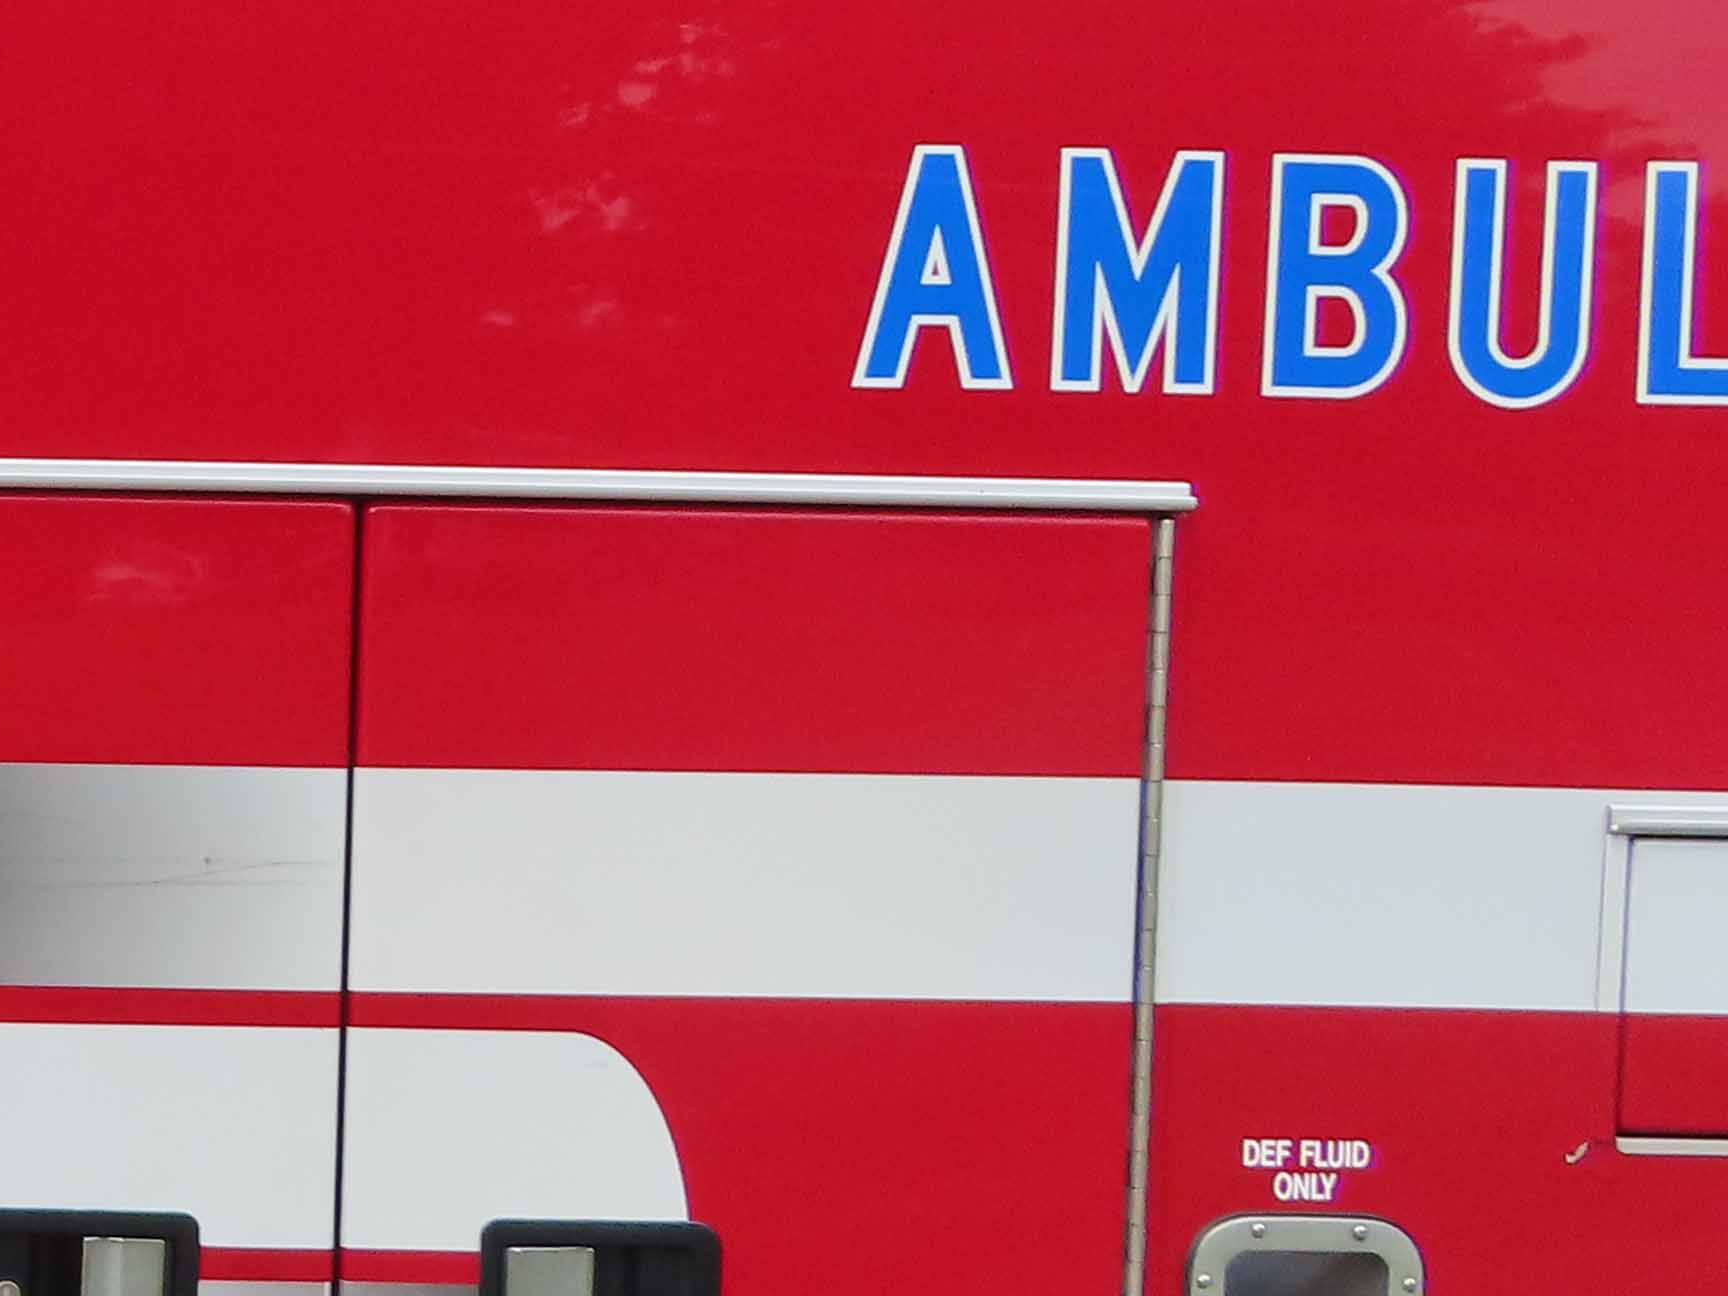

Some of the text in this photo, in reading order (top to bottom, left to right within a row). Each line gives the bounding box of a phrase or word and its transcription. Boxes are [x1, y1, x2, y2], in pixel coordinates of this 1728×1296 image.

[851, 143, 1728, 408] AMBUL
[1242, 1139, 1372, 1169] DEF FLUID
[1273, 1172, 1337, 1201] ONLY
